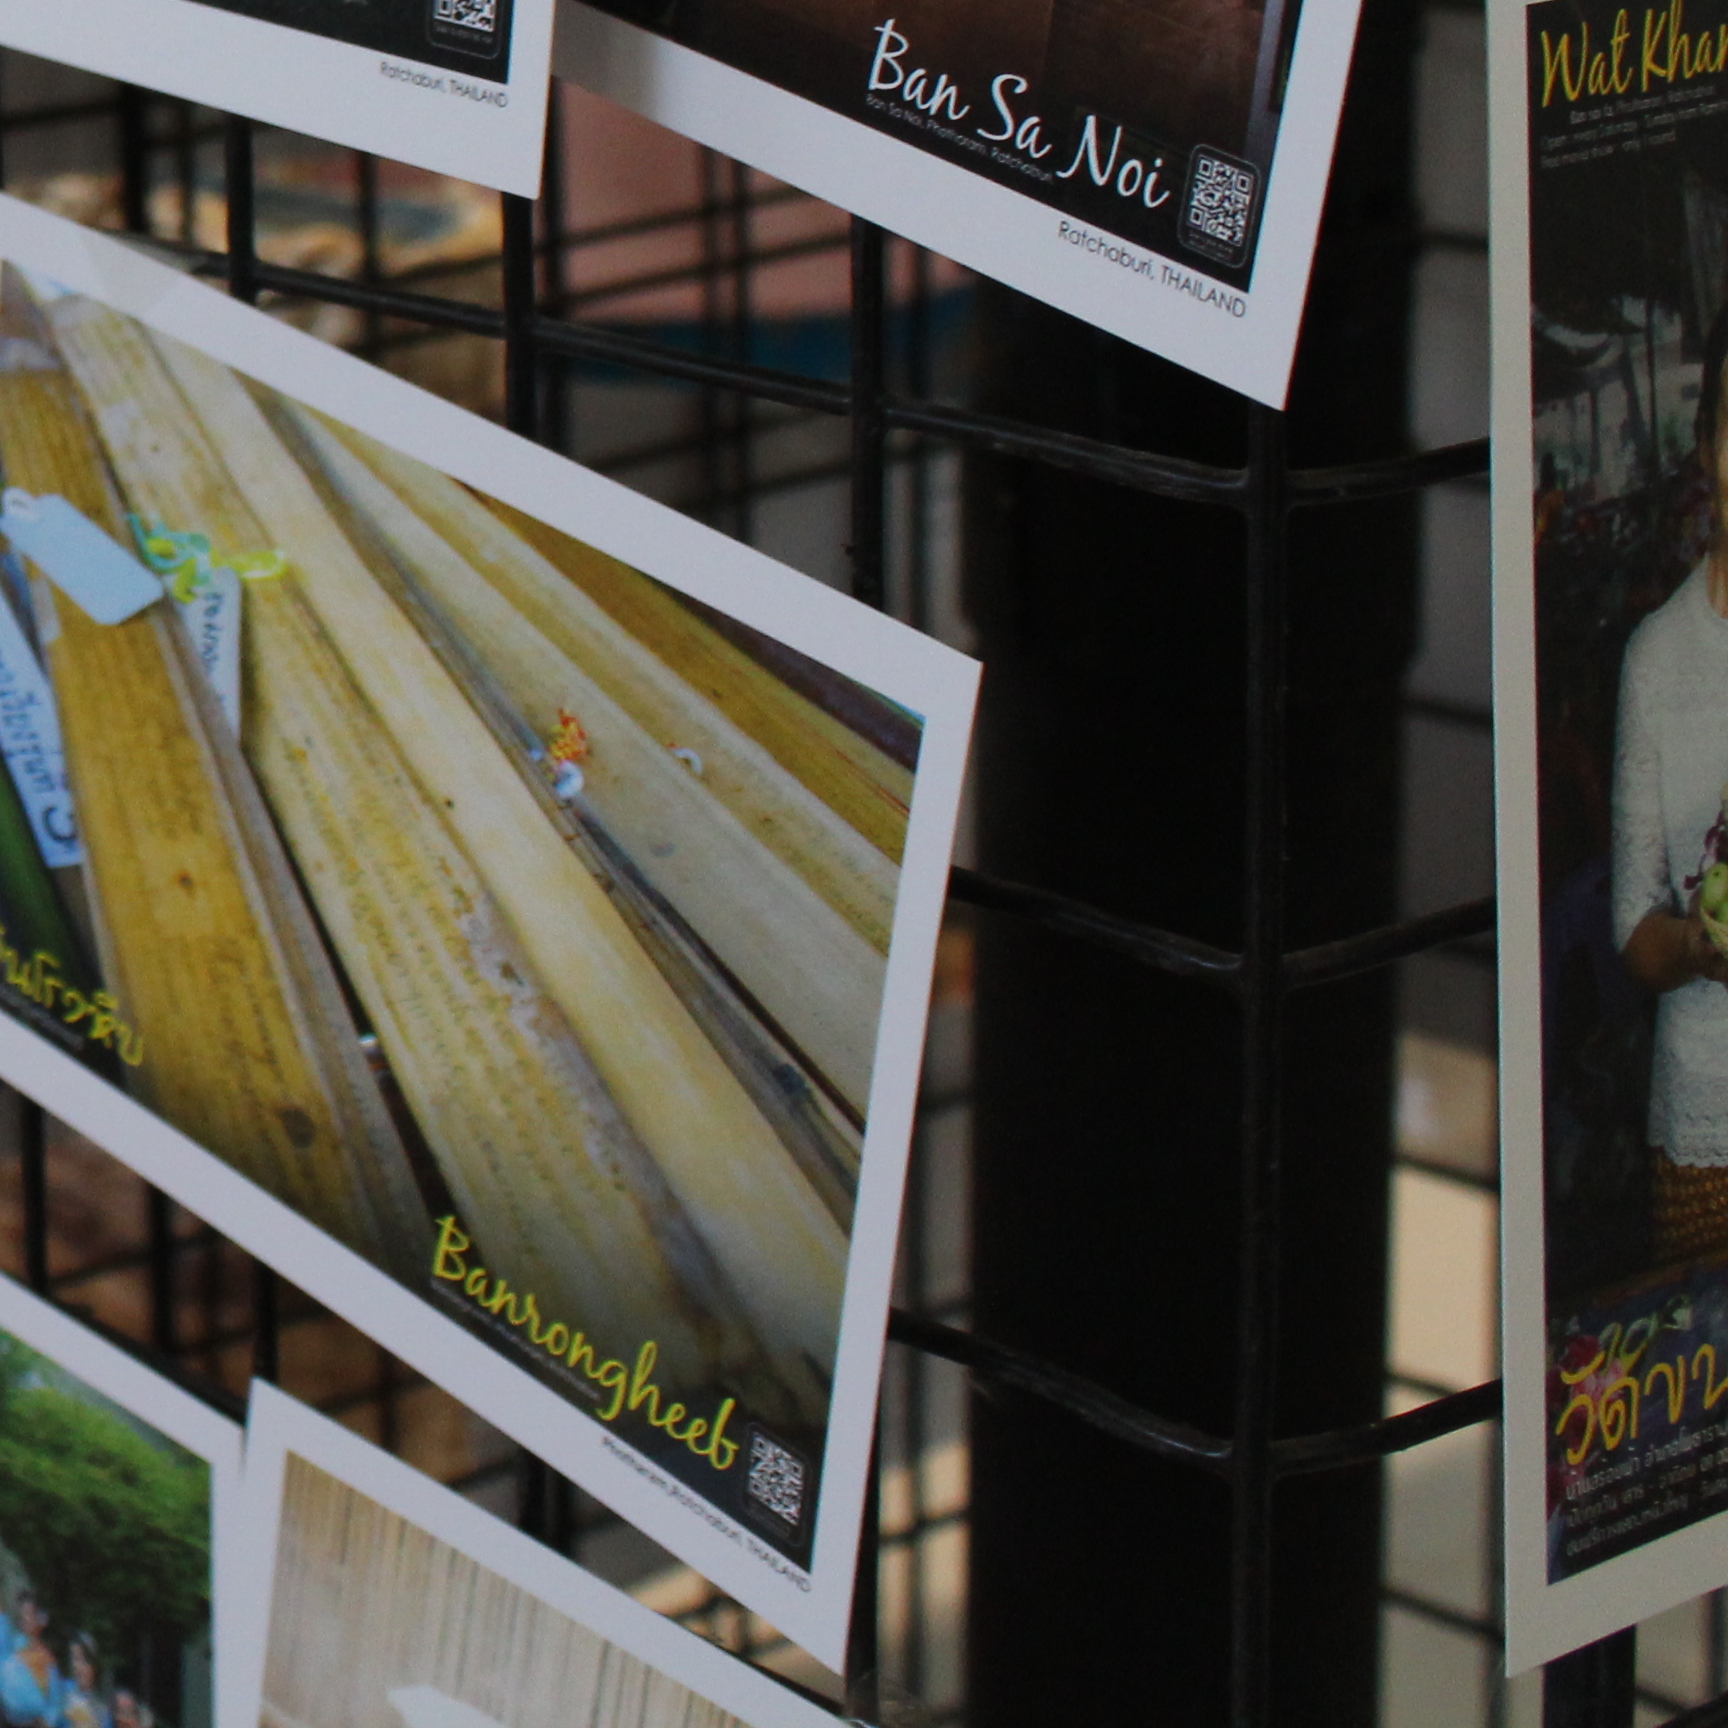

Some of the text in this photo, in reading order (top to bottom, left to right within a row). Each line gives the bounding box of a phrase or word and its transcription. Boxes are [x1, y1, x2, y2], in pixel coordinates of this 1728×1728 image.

[868, 17, 1171, 209] Ban Sa Noi
[1540, 7, 1634, 108] Wat
[1057, 219, 1155, 282] Ratchaburi,
[1160, 263, 1247, 319] THAILAND
[432, 1215, 740, 1470] Banrongheeb
